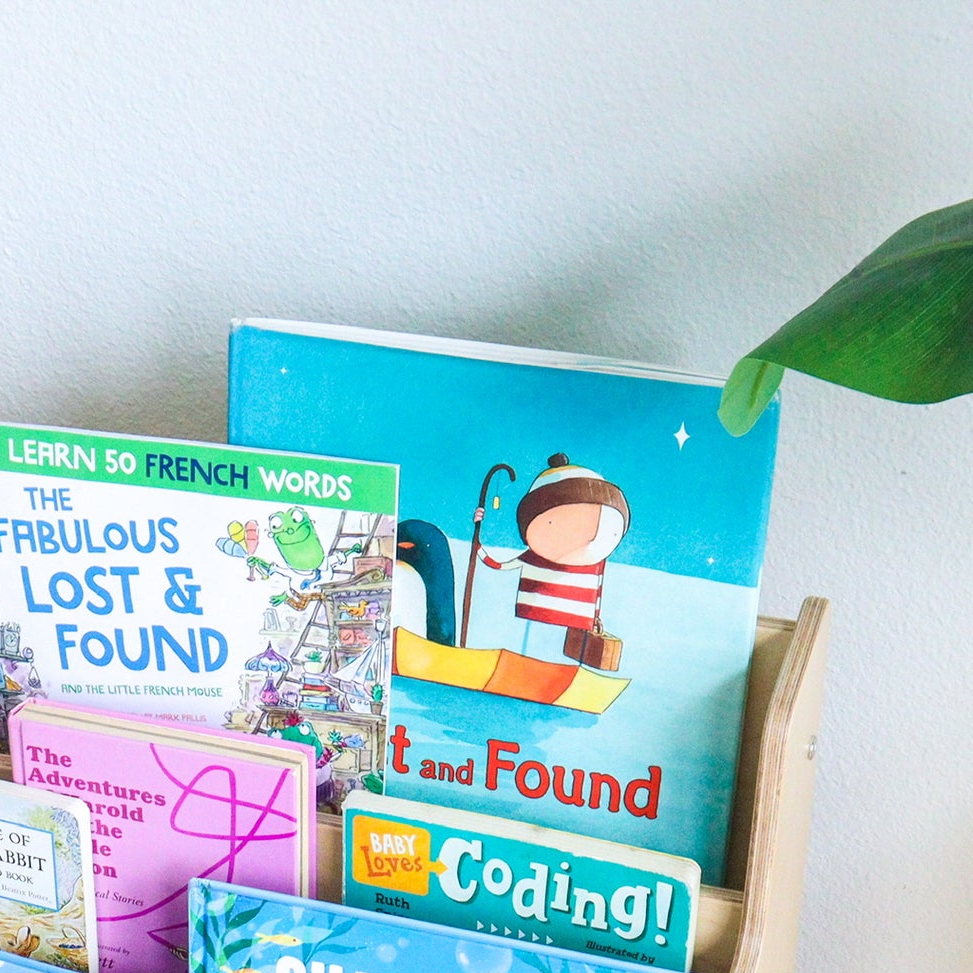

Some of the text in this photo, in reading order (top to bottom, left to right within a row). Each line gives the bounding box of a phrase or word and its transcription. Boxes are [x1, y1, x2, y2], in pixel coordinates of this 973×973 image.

[8, 437, 353, 500] LEARN 50 FRENCH WORDS
[24, 487, 74, 511] THE
[20, 565, 204, 616] LOST &
[55, 624, 229, 673] FOUND
[61, 684, 223, 697] AND THE LITTLE FRENCH MOUSE
[181, 713, 208, 723] PALLIS
[27, 745, 72, 768] The
[29, 767, 166, 806] Adventures
[421, 739, 662, 820] and Found
[9, 832, 31, 848] OF
[369, 832, 417, 857] BABY
[360, 845, 424, 878] Loves
[6, 870, 34, 885] BOOK
[2, 884, 27, 896] Beatrix
[112, 891, 144, 907] Stories
[375, 892, 410, 911] Ruth
[438, 837, 676, 946] Coding!
[585, 940, 656, 965] Illustrated by
